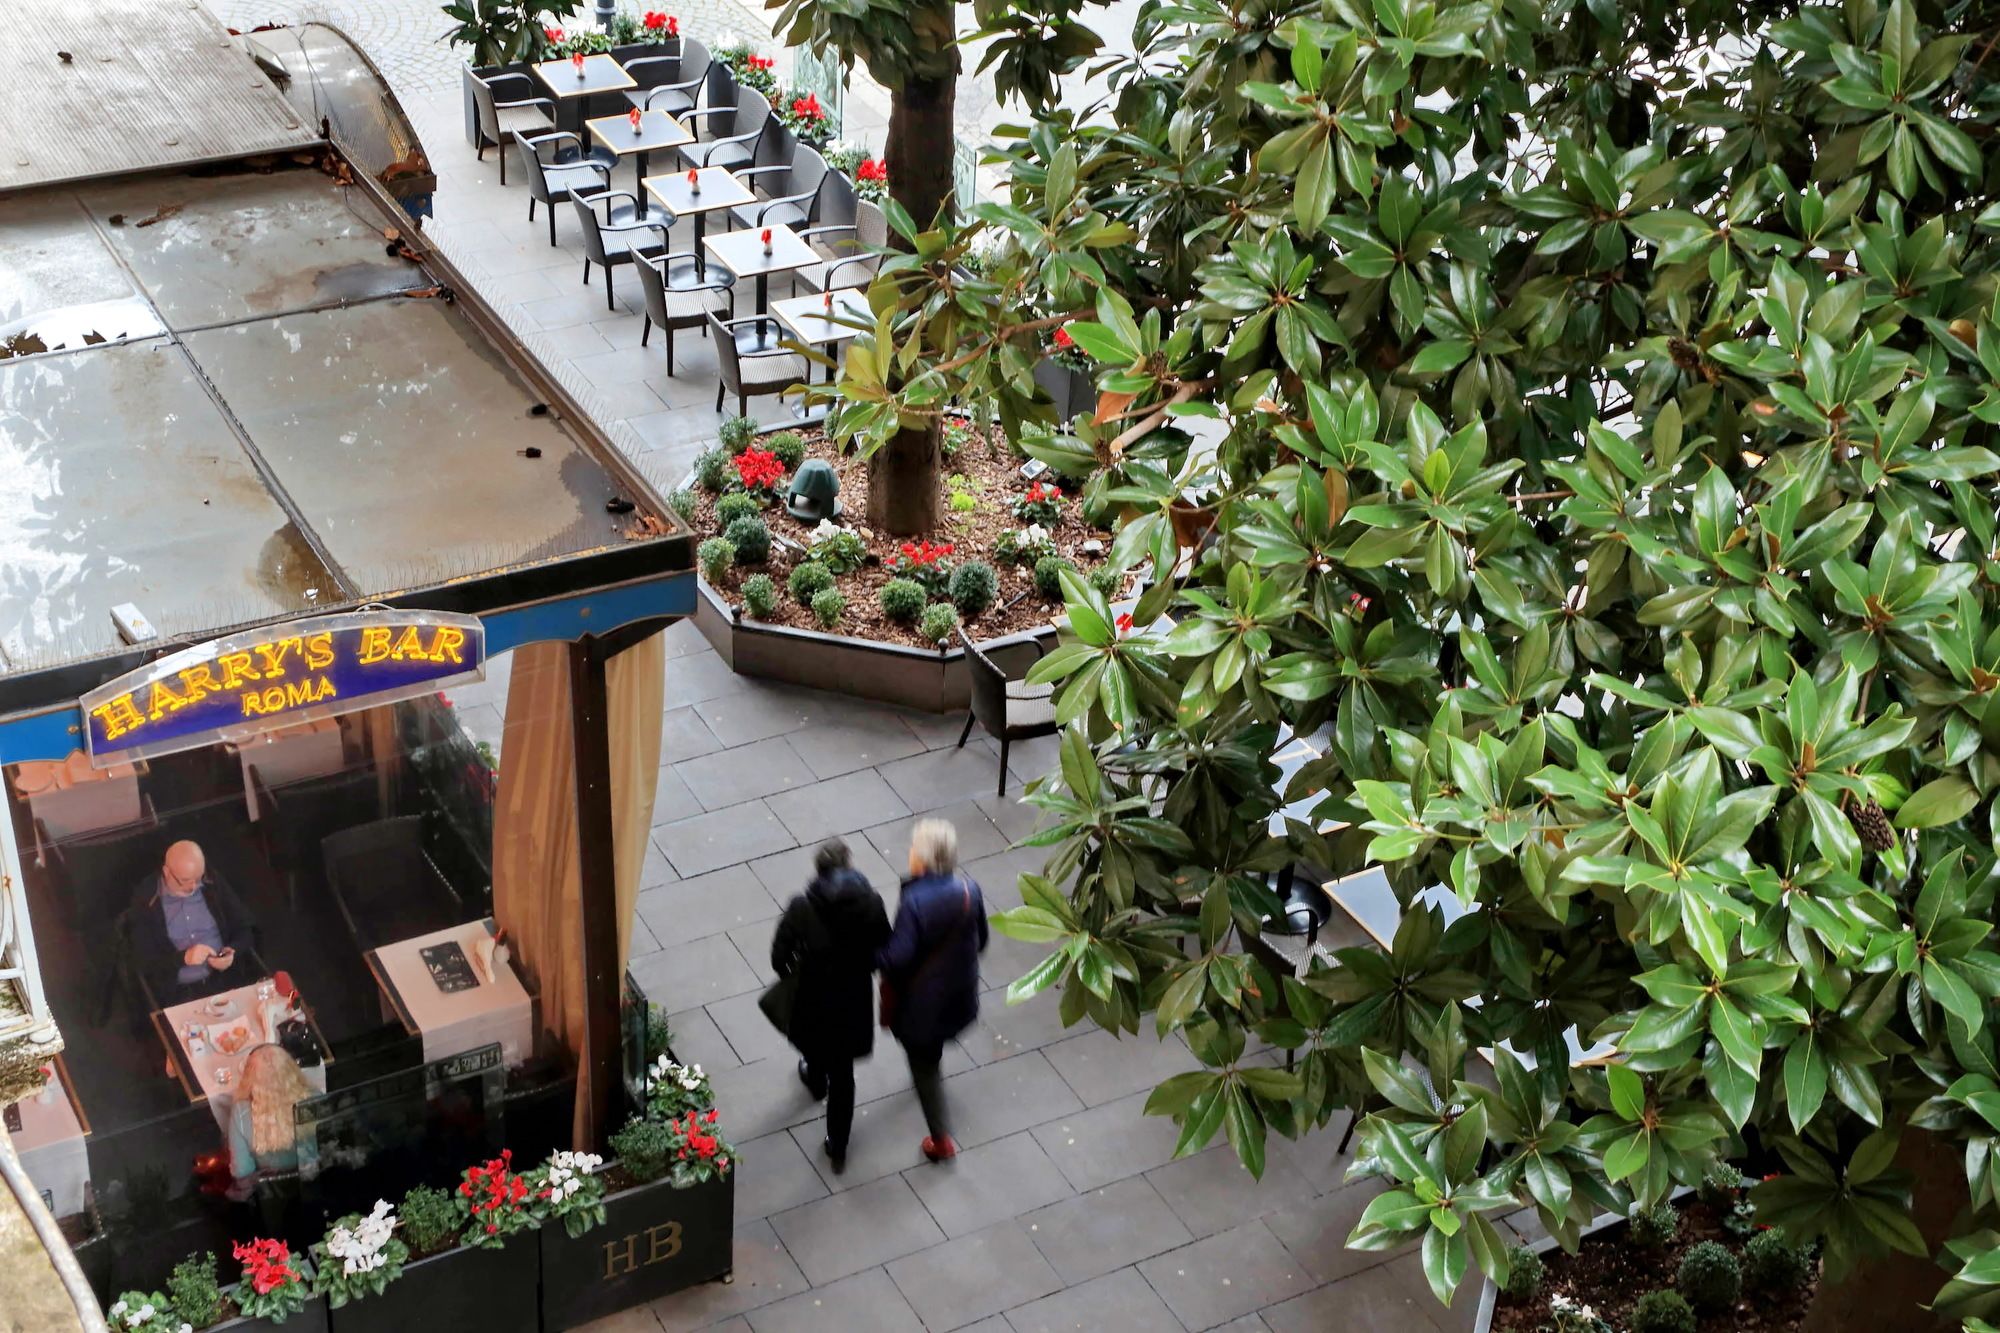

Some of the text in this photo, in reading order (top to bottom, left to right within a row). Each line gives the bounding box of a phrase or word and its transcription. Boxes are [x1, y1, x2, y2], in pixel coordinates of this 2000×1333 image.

[93, 626, 464, 741] HARRY'S BAR
[242, 675, 336, 716] ROMA
